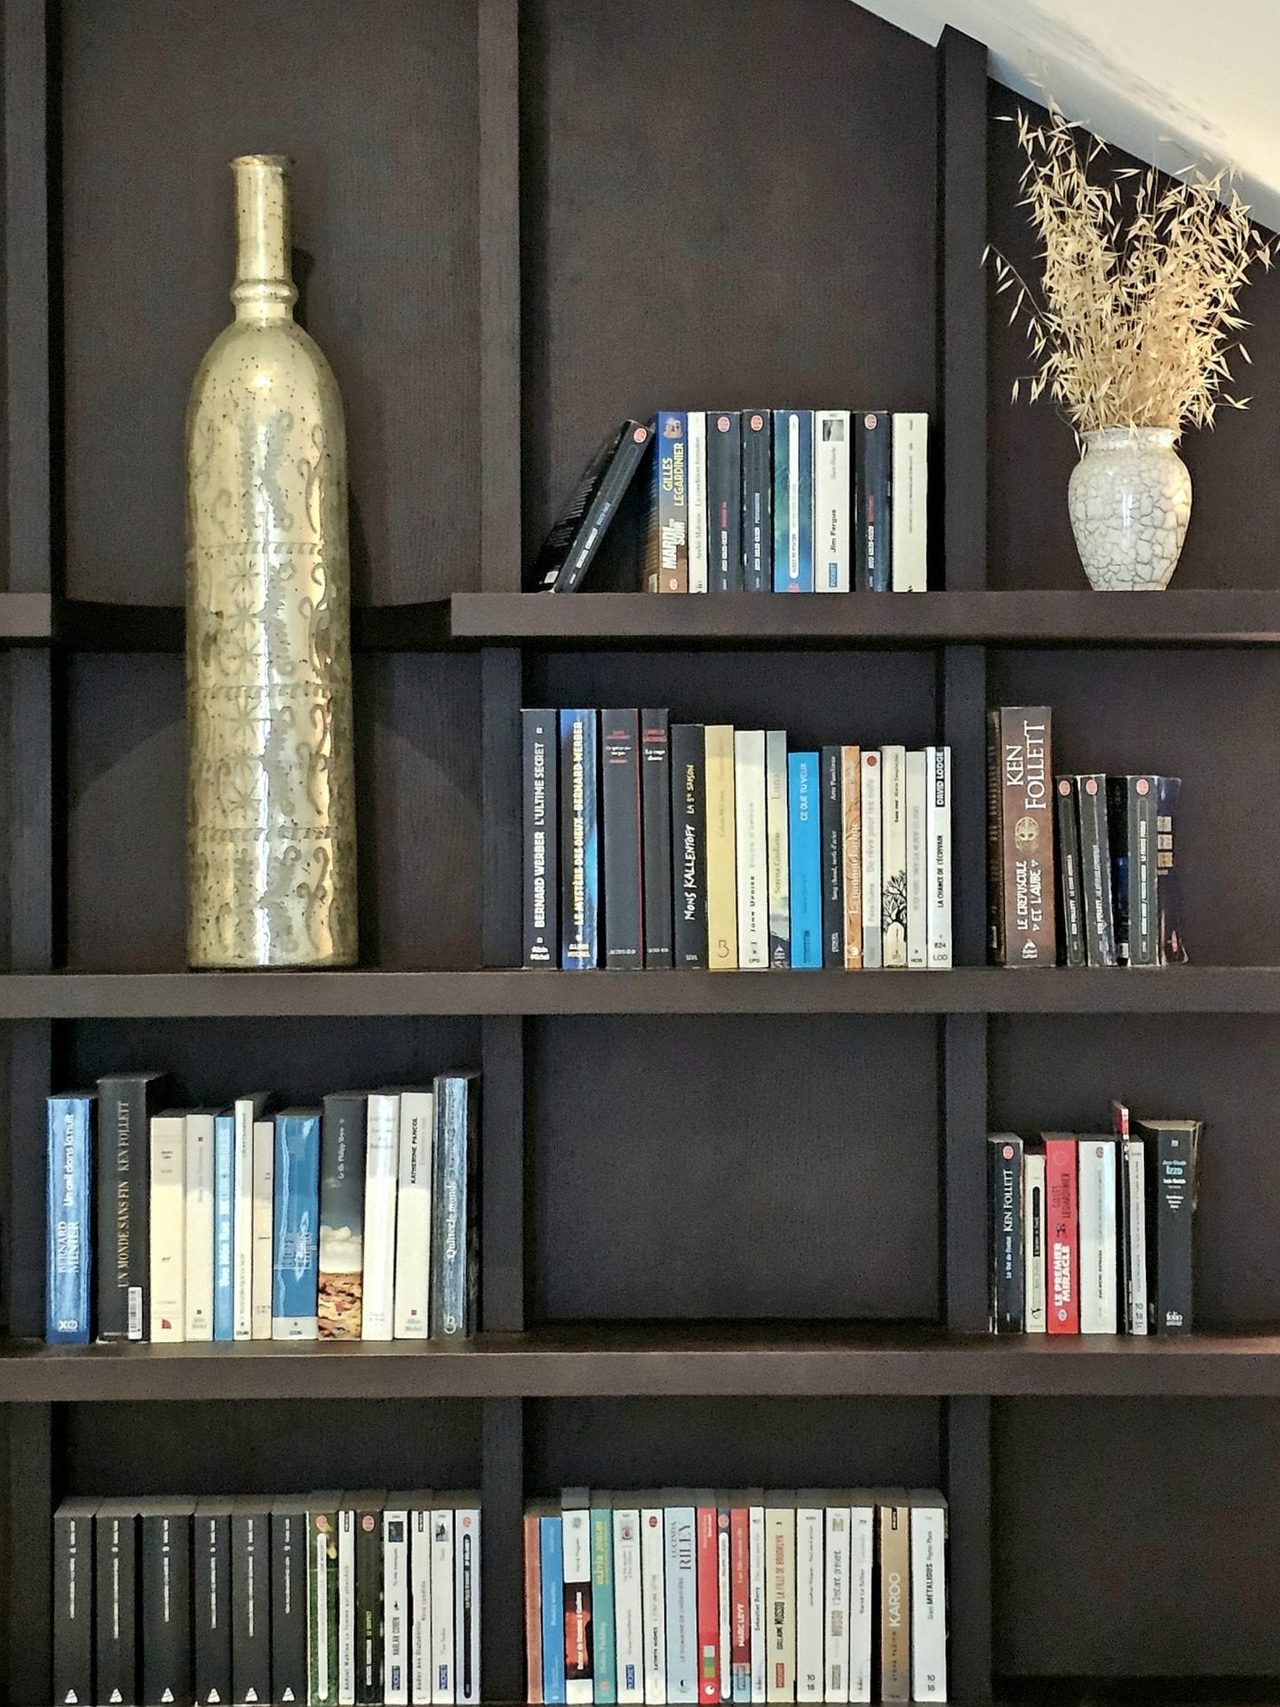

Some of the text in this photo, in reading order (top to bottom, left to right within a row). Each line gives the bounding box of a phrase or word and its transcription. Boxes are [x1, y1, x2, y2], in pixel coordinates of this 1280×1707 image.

[663, 458, 672, 491] GILLES
[674, 443, 684, 506] LEGARDINIER
[830, 509, 838, 536] Fergus
[662, 526, 677, 569] MARDI
[573, 722, 583, 760] WERBER
[686, 764, 694, 790] SAISON
[800, 763, 808, 784] VEUX
[936, 751, 944, 806] DAVID LODGE
[1006, 745, 1024, 786] KEN
[1023, 720, 1046, 809] FOLLETT
[573, 764, 583, 810] BERNARD
[800, 784, 808, 793] TU
[534, 742, 545, 928] BERNARD WERBER L'ULTIME SECRET
[574, 848, 584, 866] DES
[936, 900, 944, 908] LA
[1030, 870, 1042, 922] ET L'AUBE
[573, 914, 584, 925] LE
[1018, 918, 1028, 930] LE
[63, 1136, 74, 1147] la
[64, 1113, 74, 1135] nuit
[63, 1148, 74, 1171] dans
[64, 1193, 74, 1206] Un
[118, 1101, 129, 1286] UN MONDE SANS FIN KEN FOLLETT
[1003, 1169, 1013, 1232] KEN FOLLETT
[58, 1221, 67, 1272] BERNARD
[1053, 1243, 1063, 1306] LE PREMIER
[1062, 1245, 1070, 1302] MIRACLE
[678, 1523, 692, 1569] RILEY
[888, 1572, 901, 1627] KAROO
